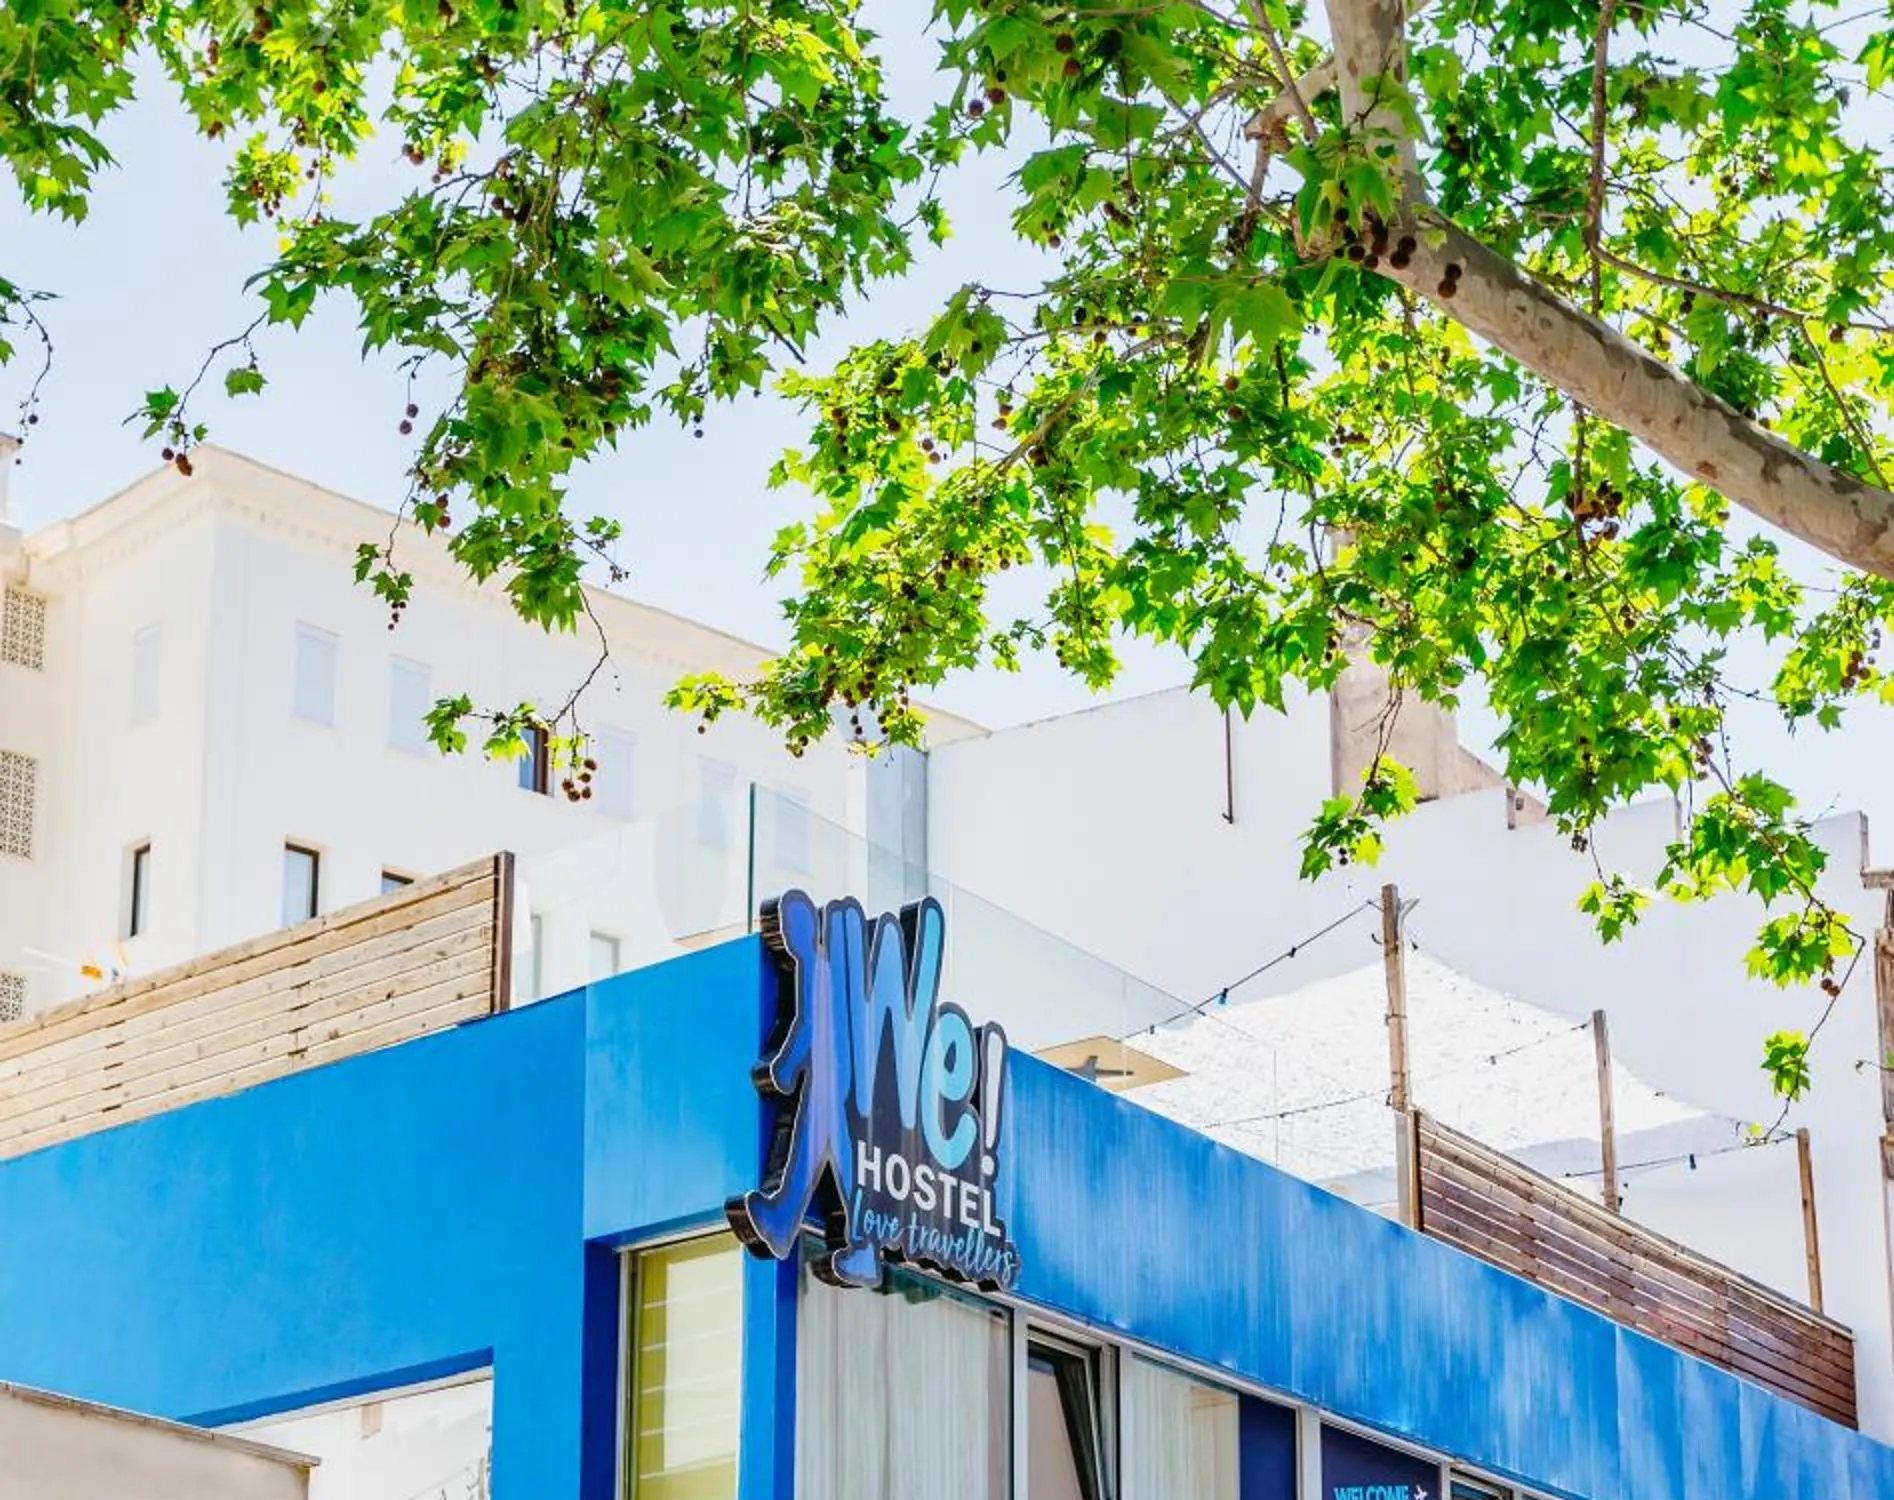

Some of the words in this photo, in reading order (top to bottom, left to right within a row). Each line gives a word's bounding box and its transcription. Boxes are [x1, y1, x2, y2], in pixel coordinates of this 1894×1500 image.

[844, 906, 1004, 1175] We!
[852, 1187, 904, 1242] Love
[857, 1139, 1002, 1237] HOSTEL
